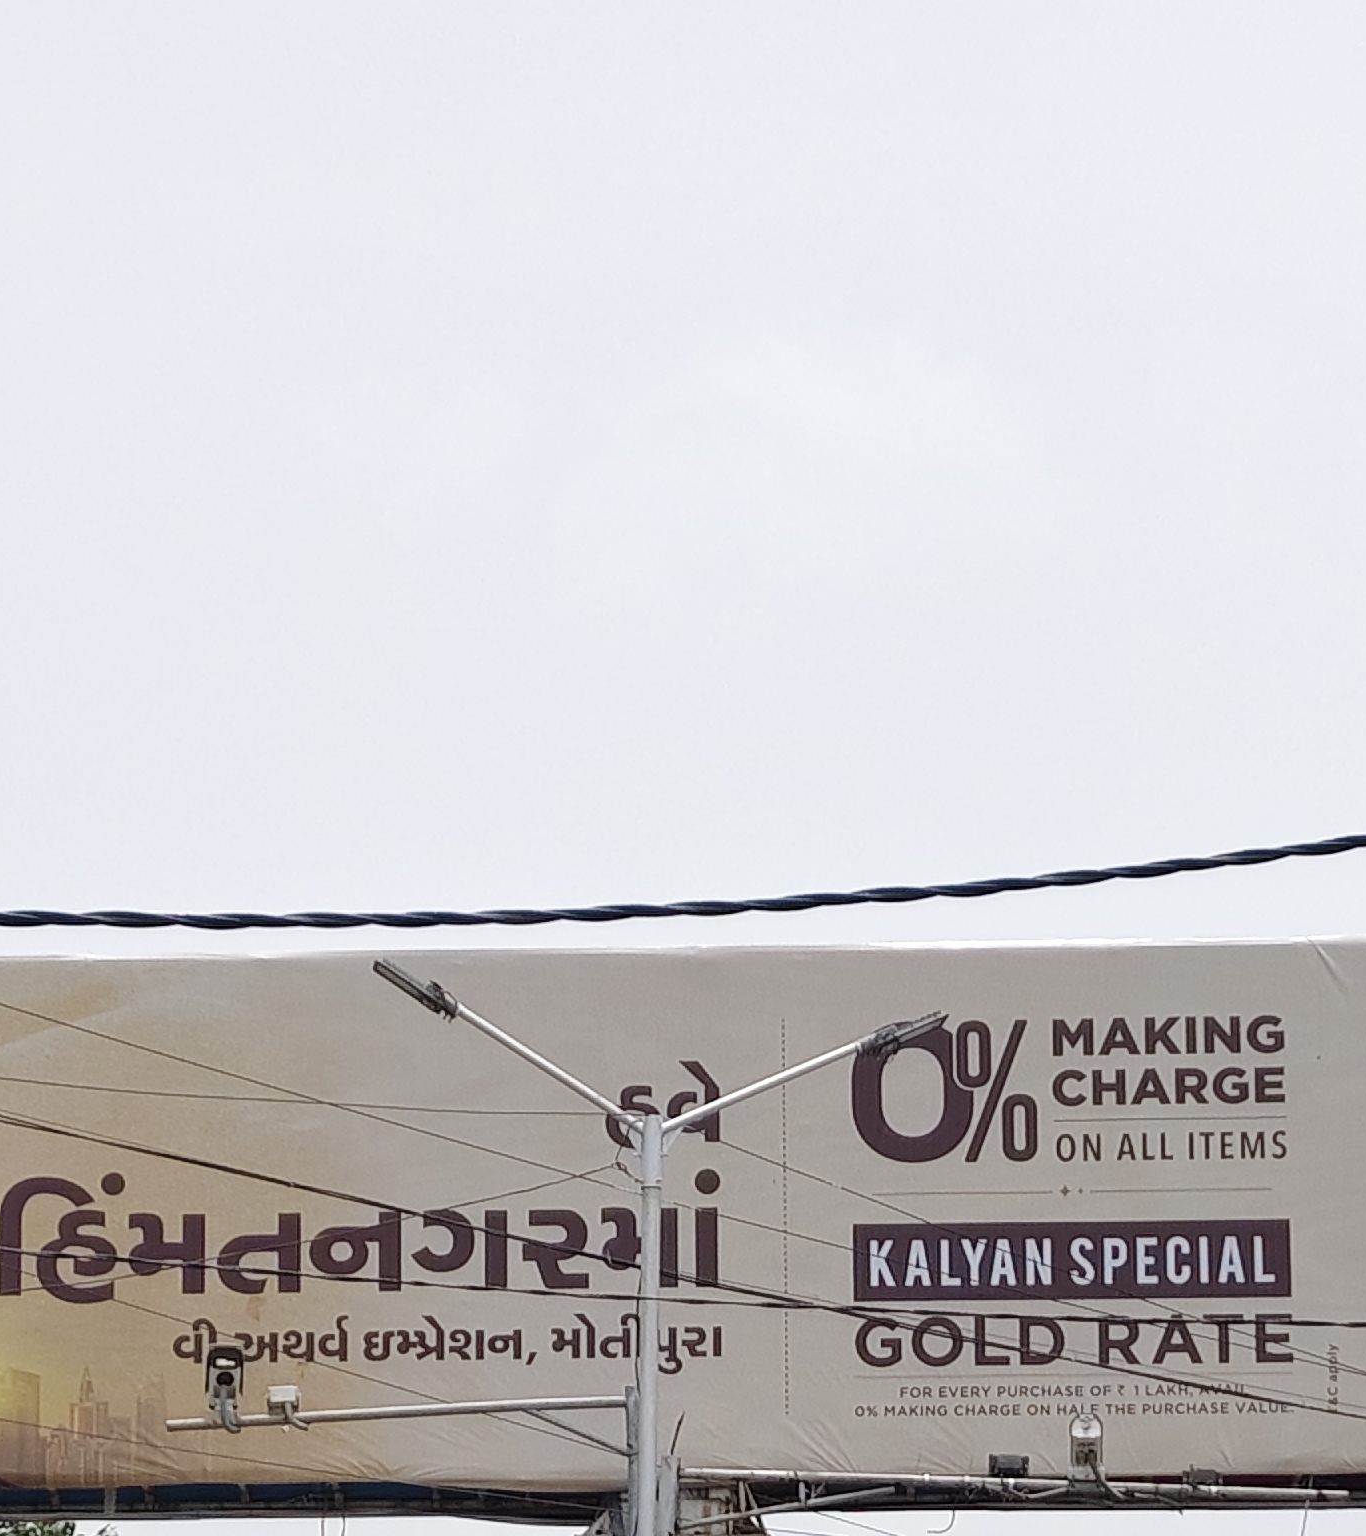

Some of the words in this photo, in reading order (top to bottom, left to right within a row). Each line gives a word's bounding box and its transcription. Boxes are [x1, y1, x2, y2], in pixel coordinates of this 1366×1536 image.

[851, 1019, 1038, 1163] 0%
[1052, 1015, 1286, 1056] MAKING
[1052, 1067, 1286, 1106] CHARGE
[1055, 1132, 1102, 1162] ON
[1116, 1131, 1175, 1161] ALL
[1187, 1129, 1288, 1160] ITEMS
[868, 1237, 1053, 1288] KALYAN
[1069, 1235, 1276, 1284] SPECIAL
[854, 1314, 1065, 1367] GOLD
[1098, 1313, 1294, 1364] RATE
[1326, 1343, 1340, 1382] apply
[854, 1405, 878, 1418] 0%
[884, 1404, 948, 1417] MAKING
[953, 1403, 1022, 1417] CHARGE
[1026, 1403, 1051, 1416] ON
[1056, 1402, 1099, 1416] HALF
[1105, 1403, 1136, 1415] THE
[1142, 1402, 1230, 1415] PURCHASE
[899, 1386, 933, 1399] FOR
[938, 1385, 992, 1398] EVERY
[996, 1385, 1084, 1398] PURCHASE
[1089, 1384, 1112, 1397] OF
[1145, 1383, 1195, 1398] LAKH,
